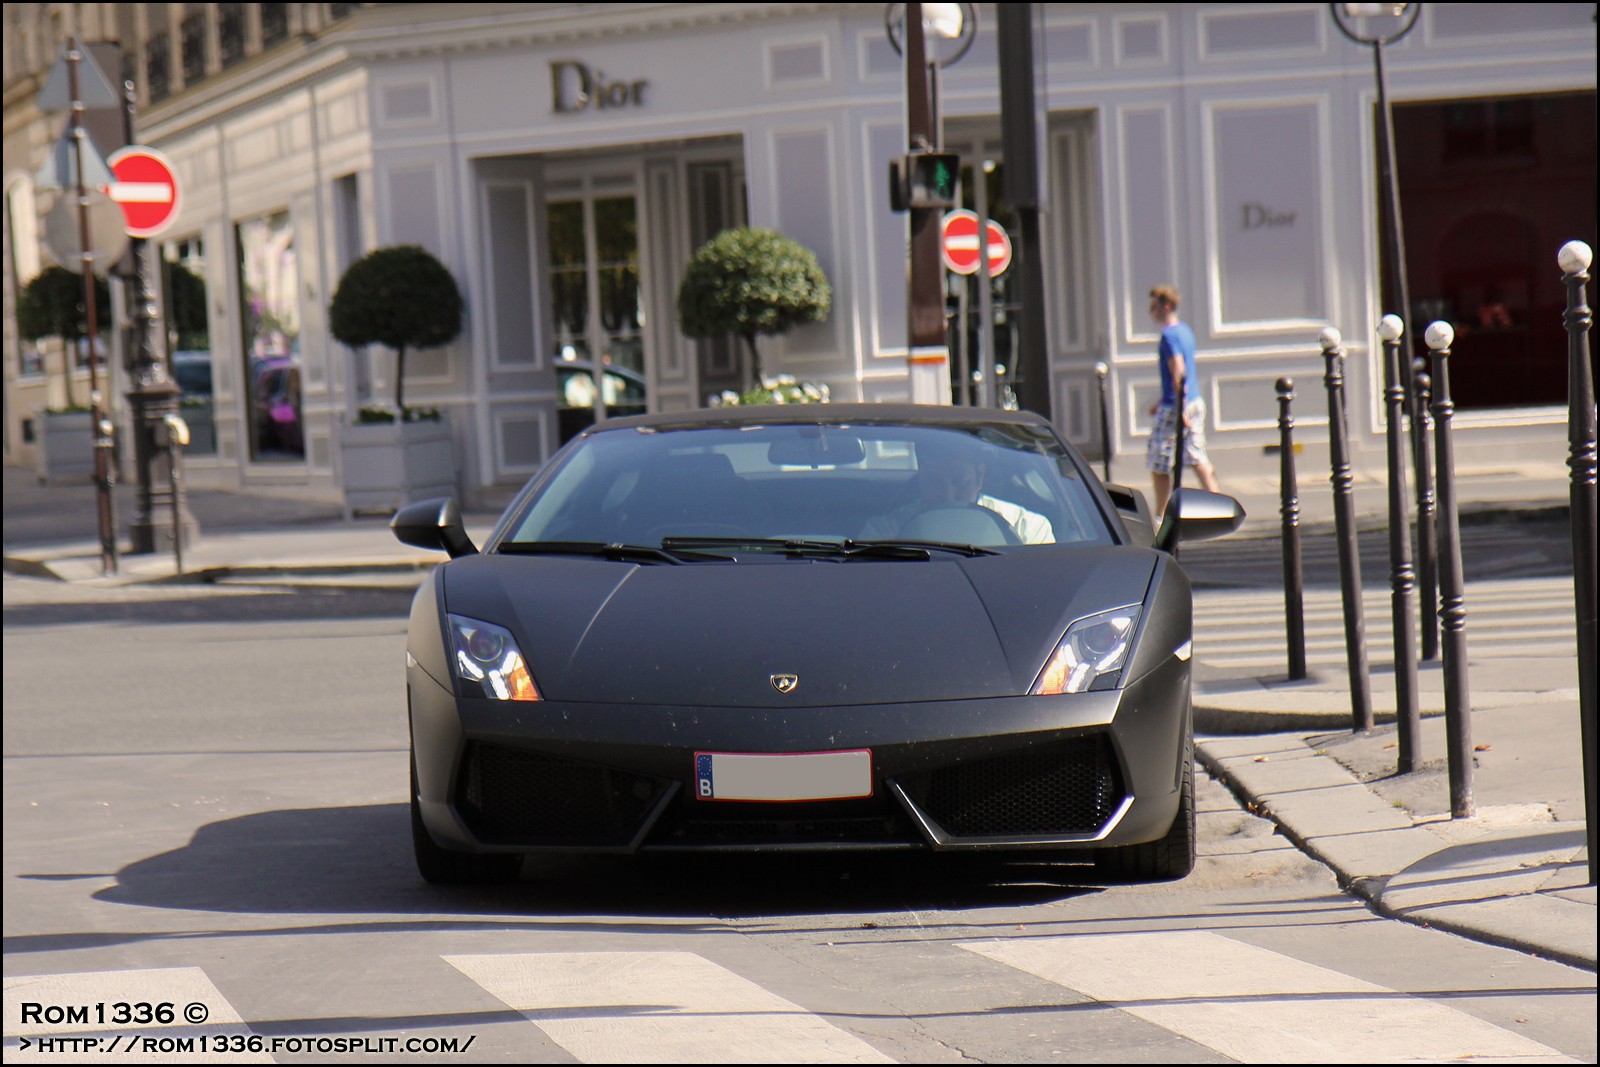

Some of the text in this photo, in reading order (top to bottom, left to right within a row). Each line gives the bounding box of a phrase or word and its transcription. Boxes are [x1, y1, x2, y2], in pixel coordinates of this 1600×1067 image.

[549, 58, 649, 113] Dior
[1240, 203, 1297, 230] Dior
[700, 779, 712, 797] B
